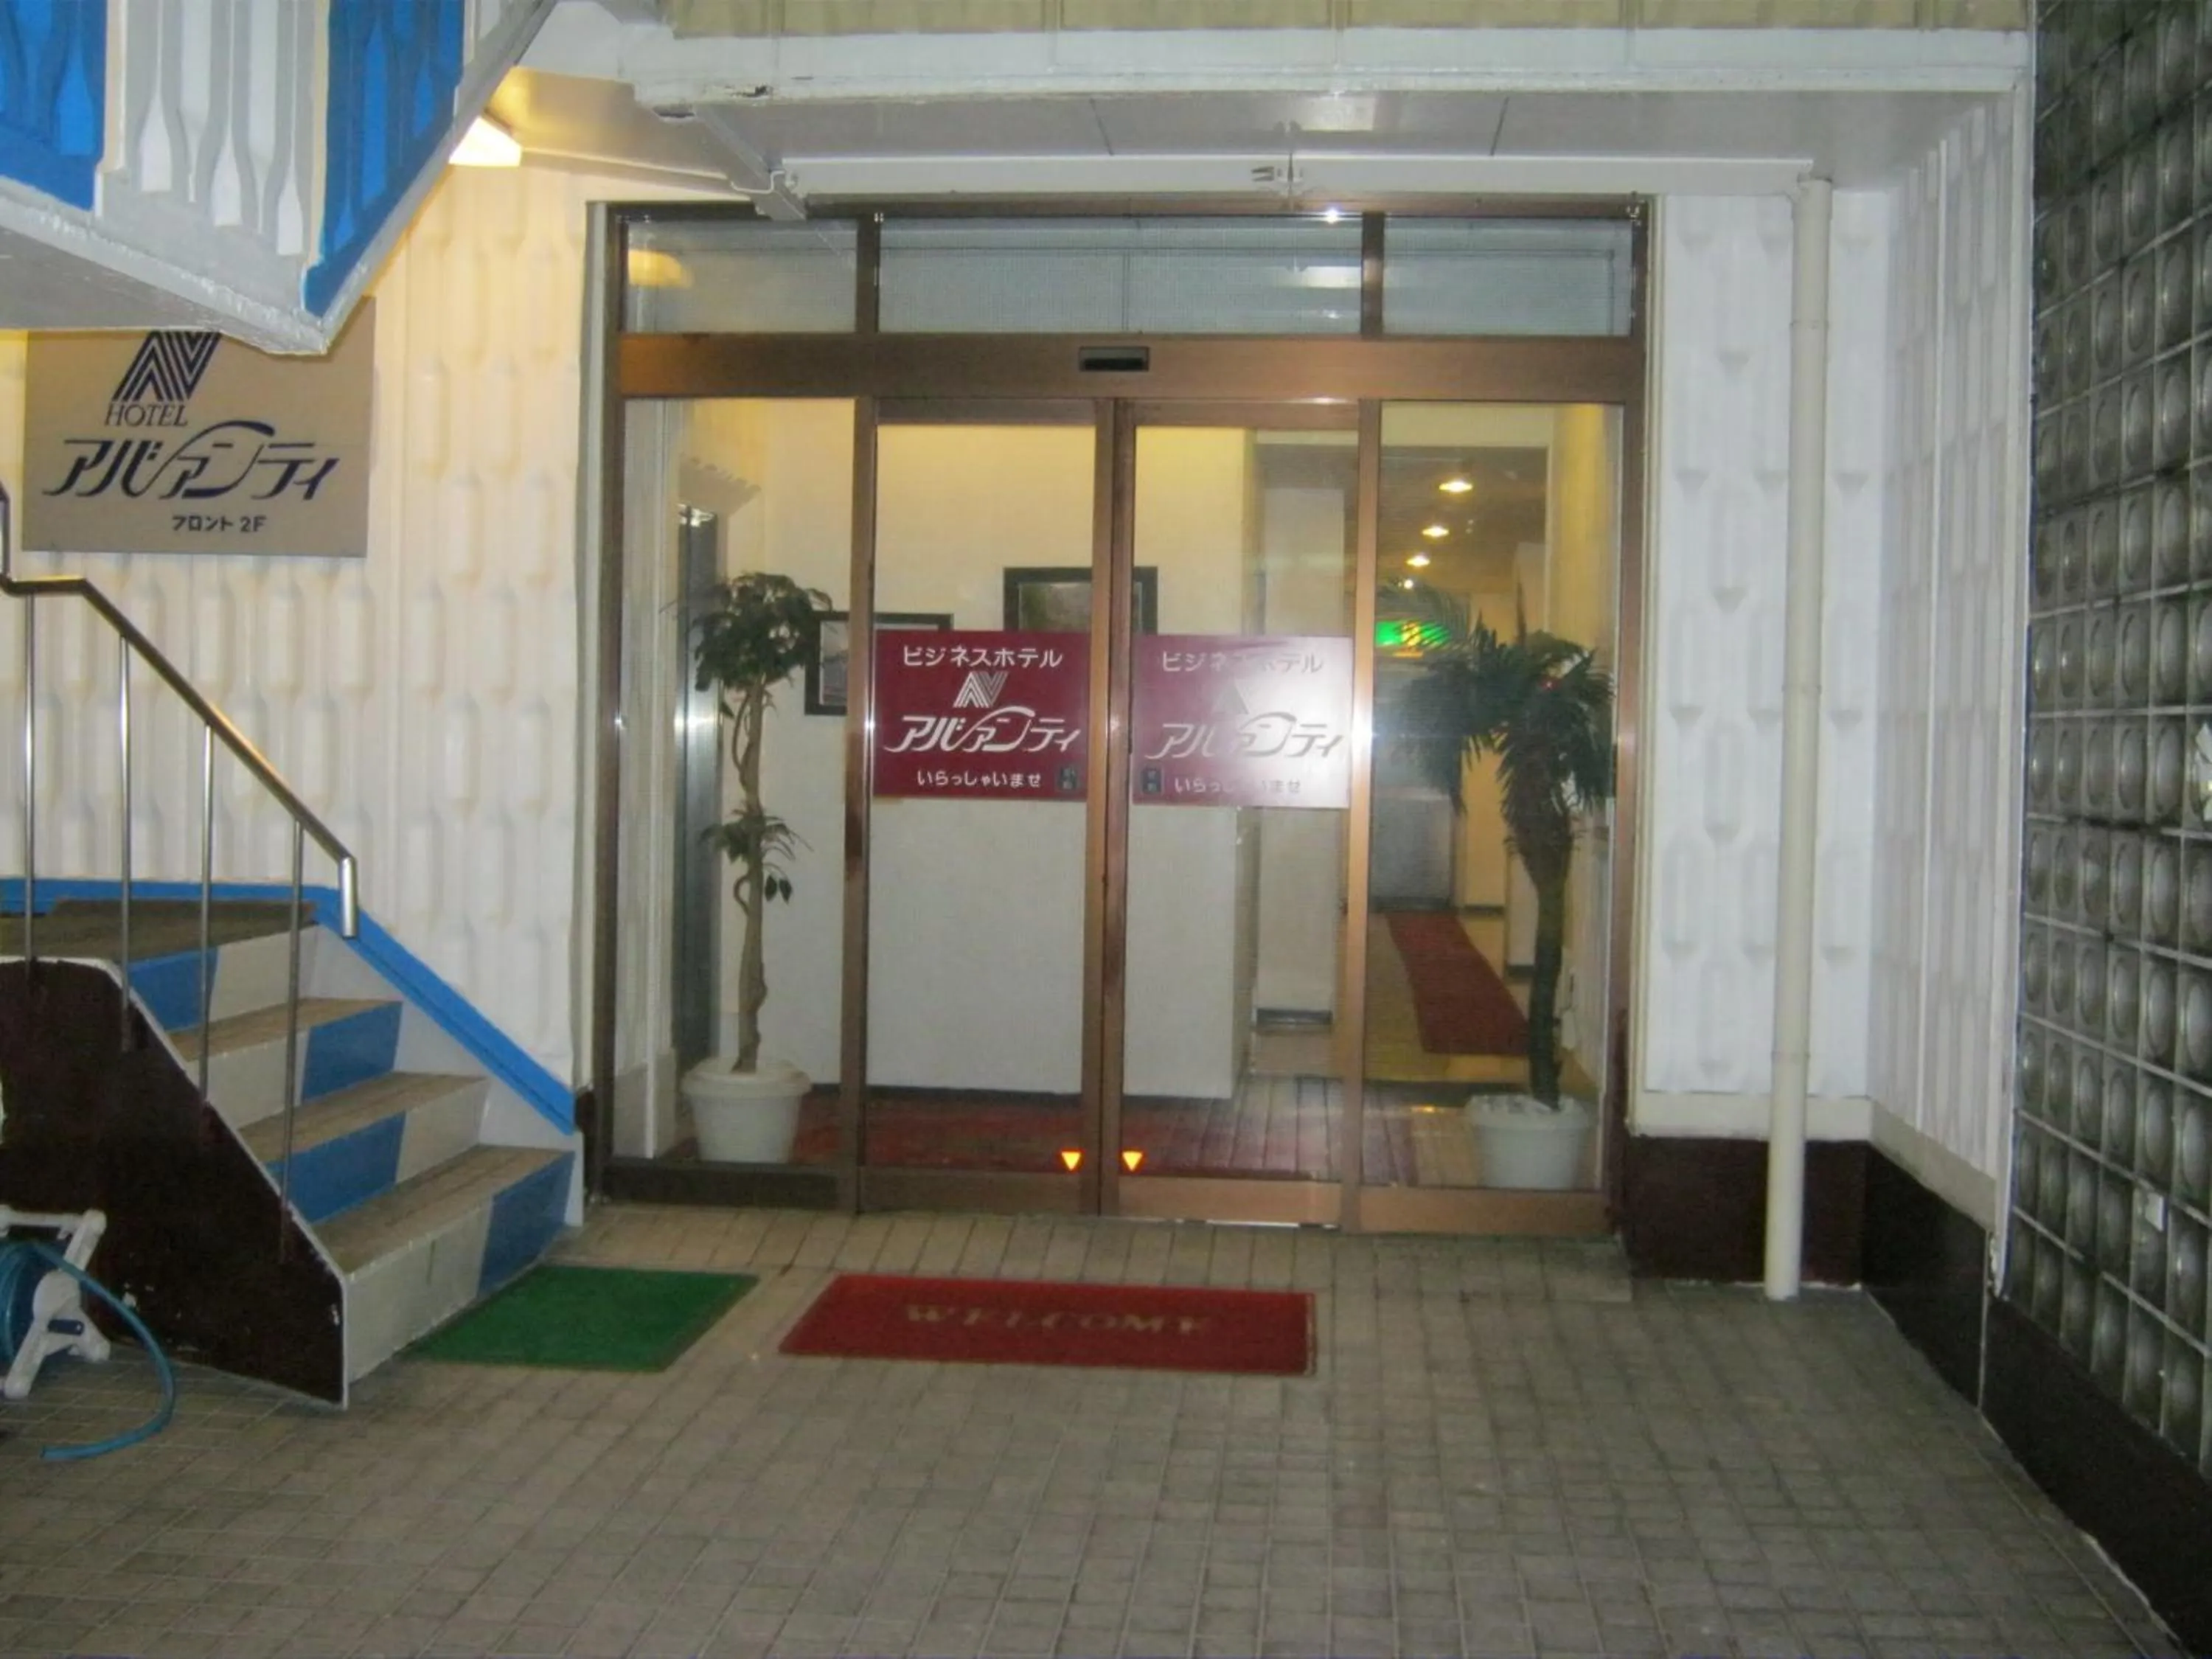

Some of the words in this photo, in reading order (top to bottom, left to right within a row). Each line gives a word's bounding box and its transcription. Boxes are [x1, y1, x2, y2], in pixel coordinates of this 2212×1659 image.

[104, 403, 189, 428] HOTEL
[172, 515, 234, 532] フロント
[240, 516, 268, 532] 2F
[902, 644, 1063, 669] ビジネスホテル
[917, 770, 1043, 789] いらっしゃいませ
